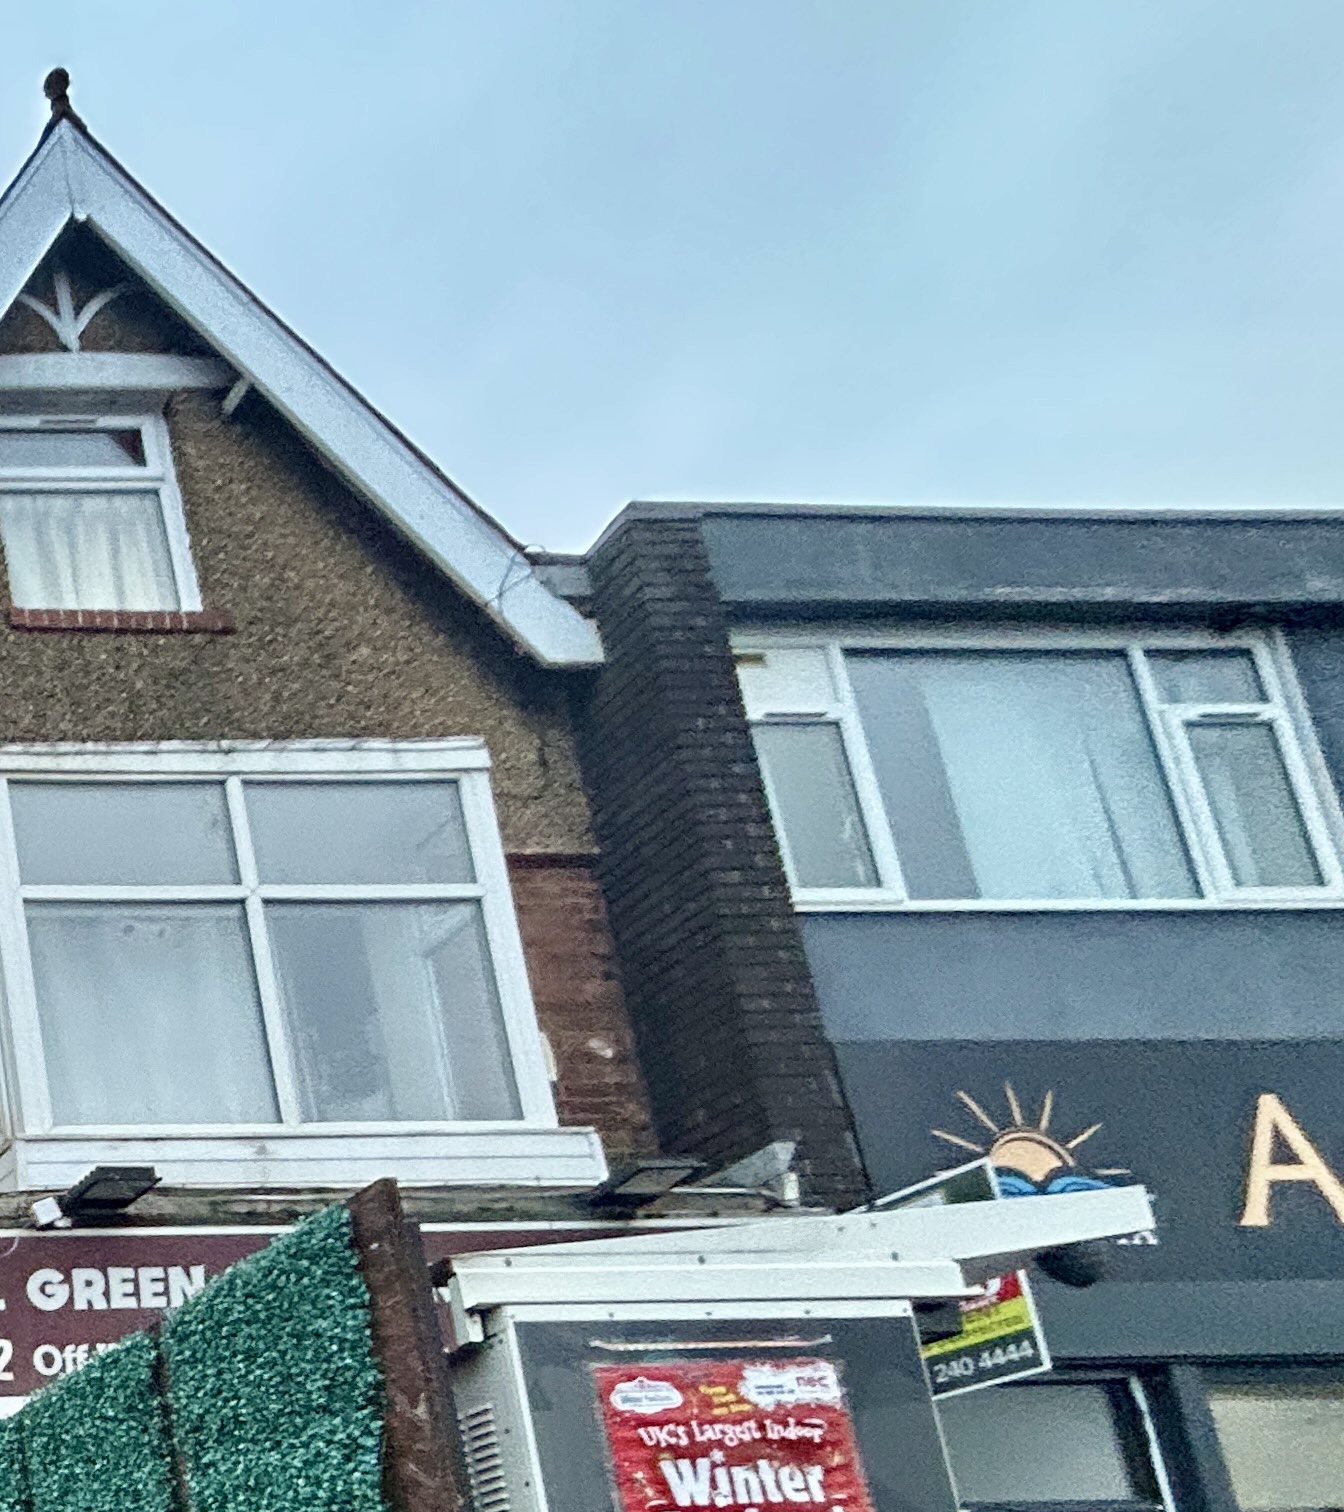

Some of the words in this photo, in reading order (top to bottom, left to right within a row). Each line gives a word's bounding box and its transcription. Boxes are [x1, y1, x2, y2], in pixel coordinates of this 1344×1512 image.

[27, 1264, 205, 1312] GREEN
[638, 1423, 689, 1447] UK's
[691, 1419, 760, 1447] Largest
[659, 1449, 826, 1507] Winter
